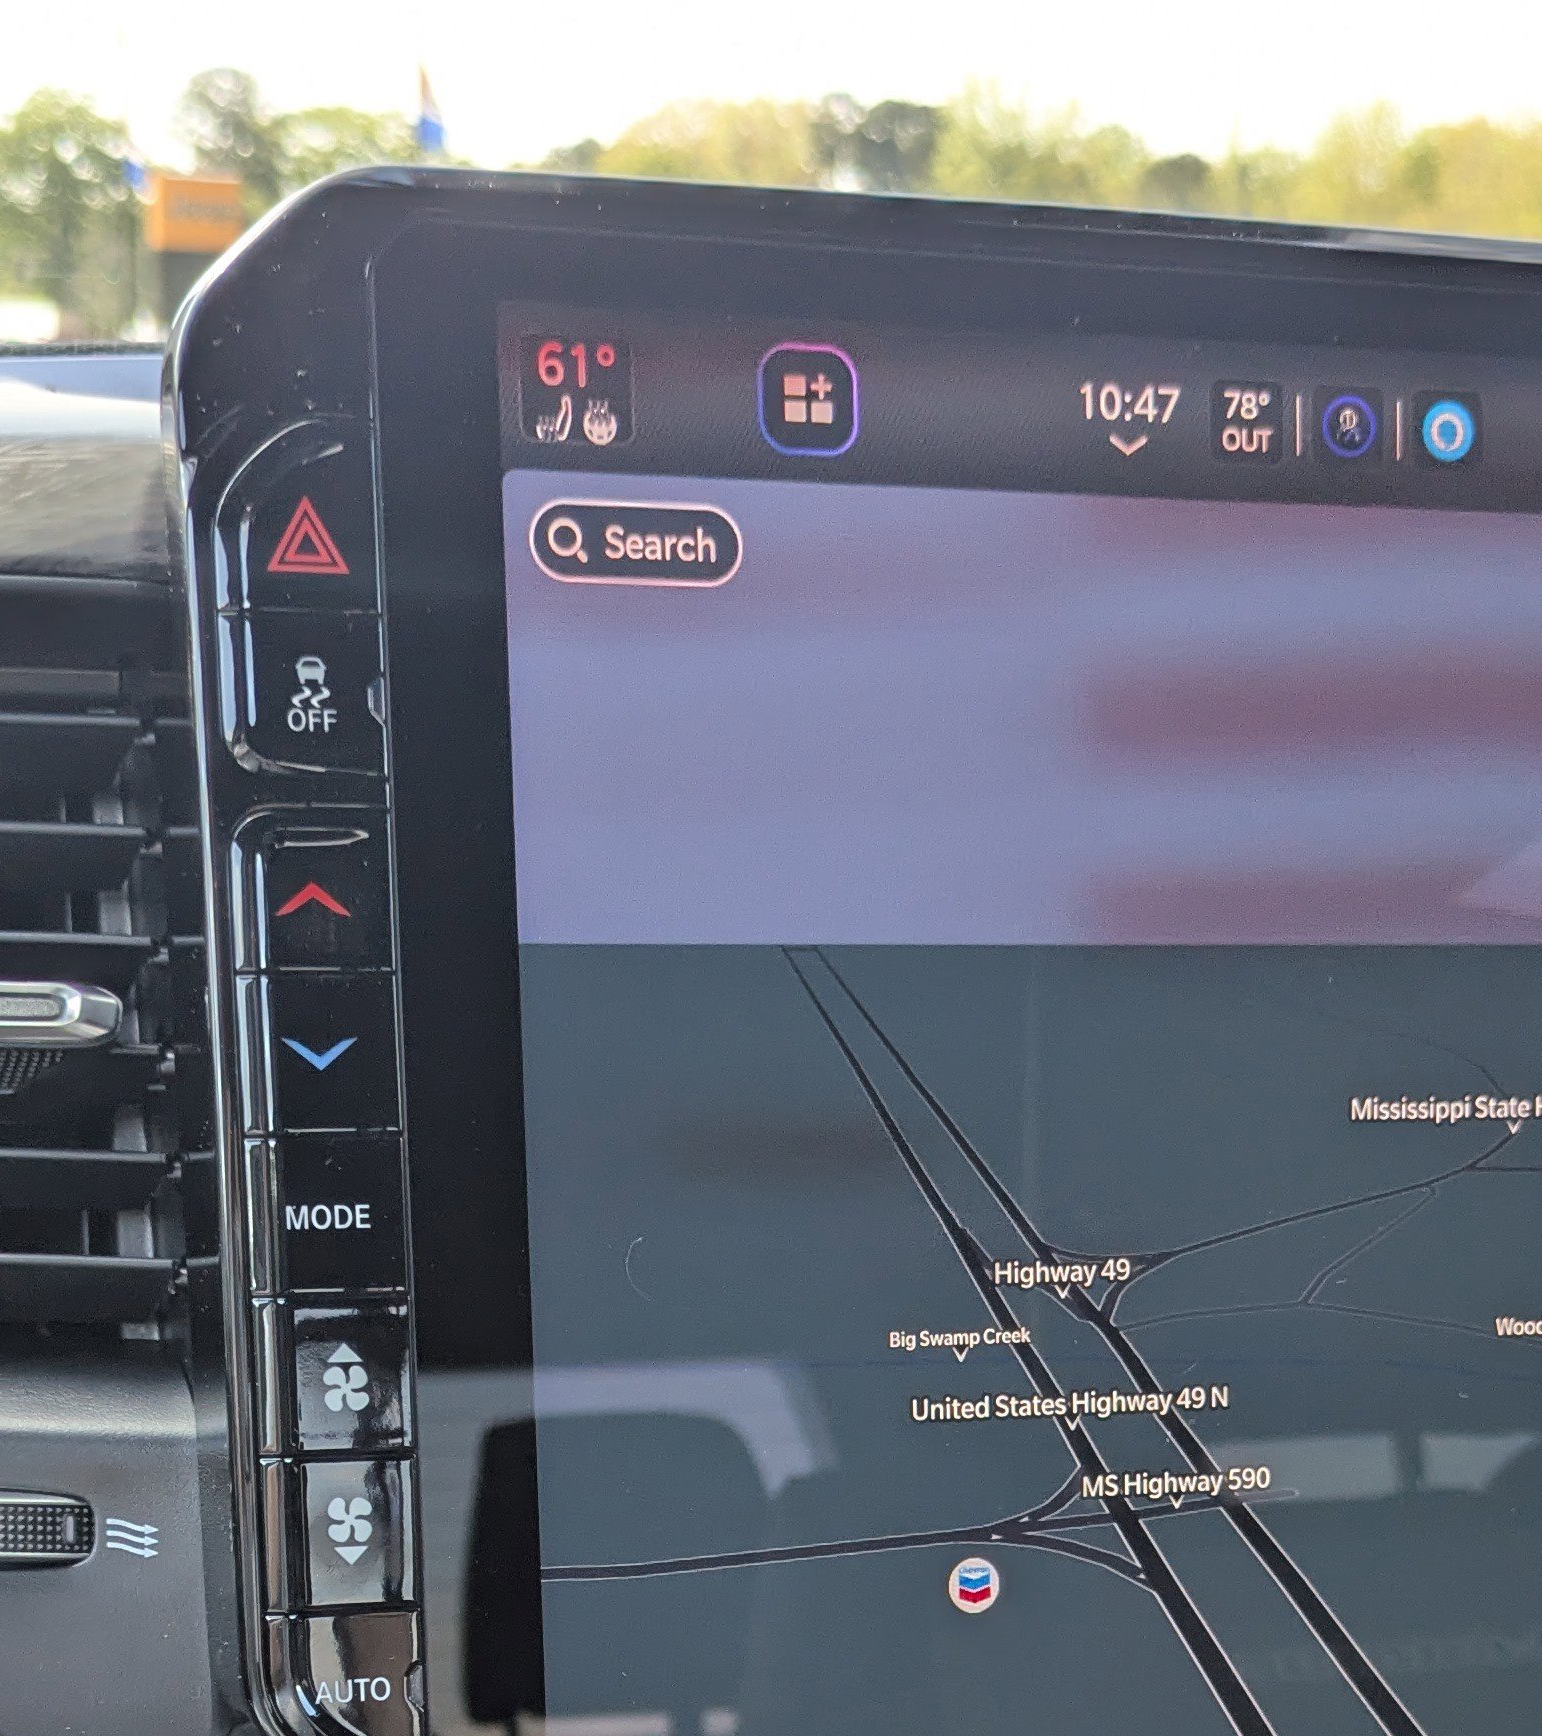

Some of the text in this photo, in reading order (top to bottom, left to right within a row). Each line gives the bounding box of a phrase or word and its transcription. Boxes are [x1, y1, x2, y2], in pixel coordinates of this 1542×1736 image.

[536, 340, 616, 389] 61°
[1079, 382, 1181, 423] 10:47
[1223, 389, 1271, 419] 78°
[1222, 427, 1273, 453] OUT
[604, 524, 717, 565] Search
[287, 708, 338, 733] OFF
[1350, 1097, 1471, 1124] Mississippi
[1474, 1096, 1530, 1119] State
[285, 1204, 371, 1231] MODE
[994, 1258, 1130, 1288] Highway 49
[889, 1327, 1031, 1351] Big Swamp Creek
[912, 1386, 1229, 1421] United States Highway 49 N
[1082, 1467, 1270, 1497] MS Highway 590
[315, 1676, 391, 1705] AUTO
